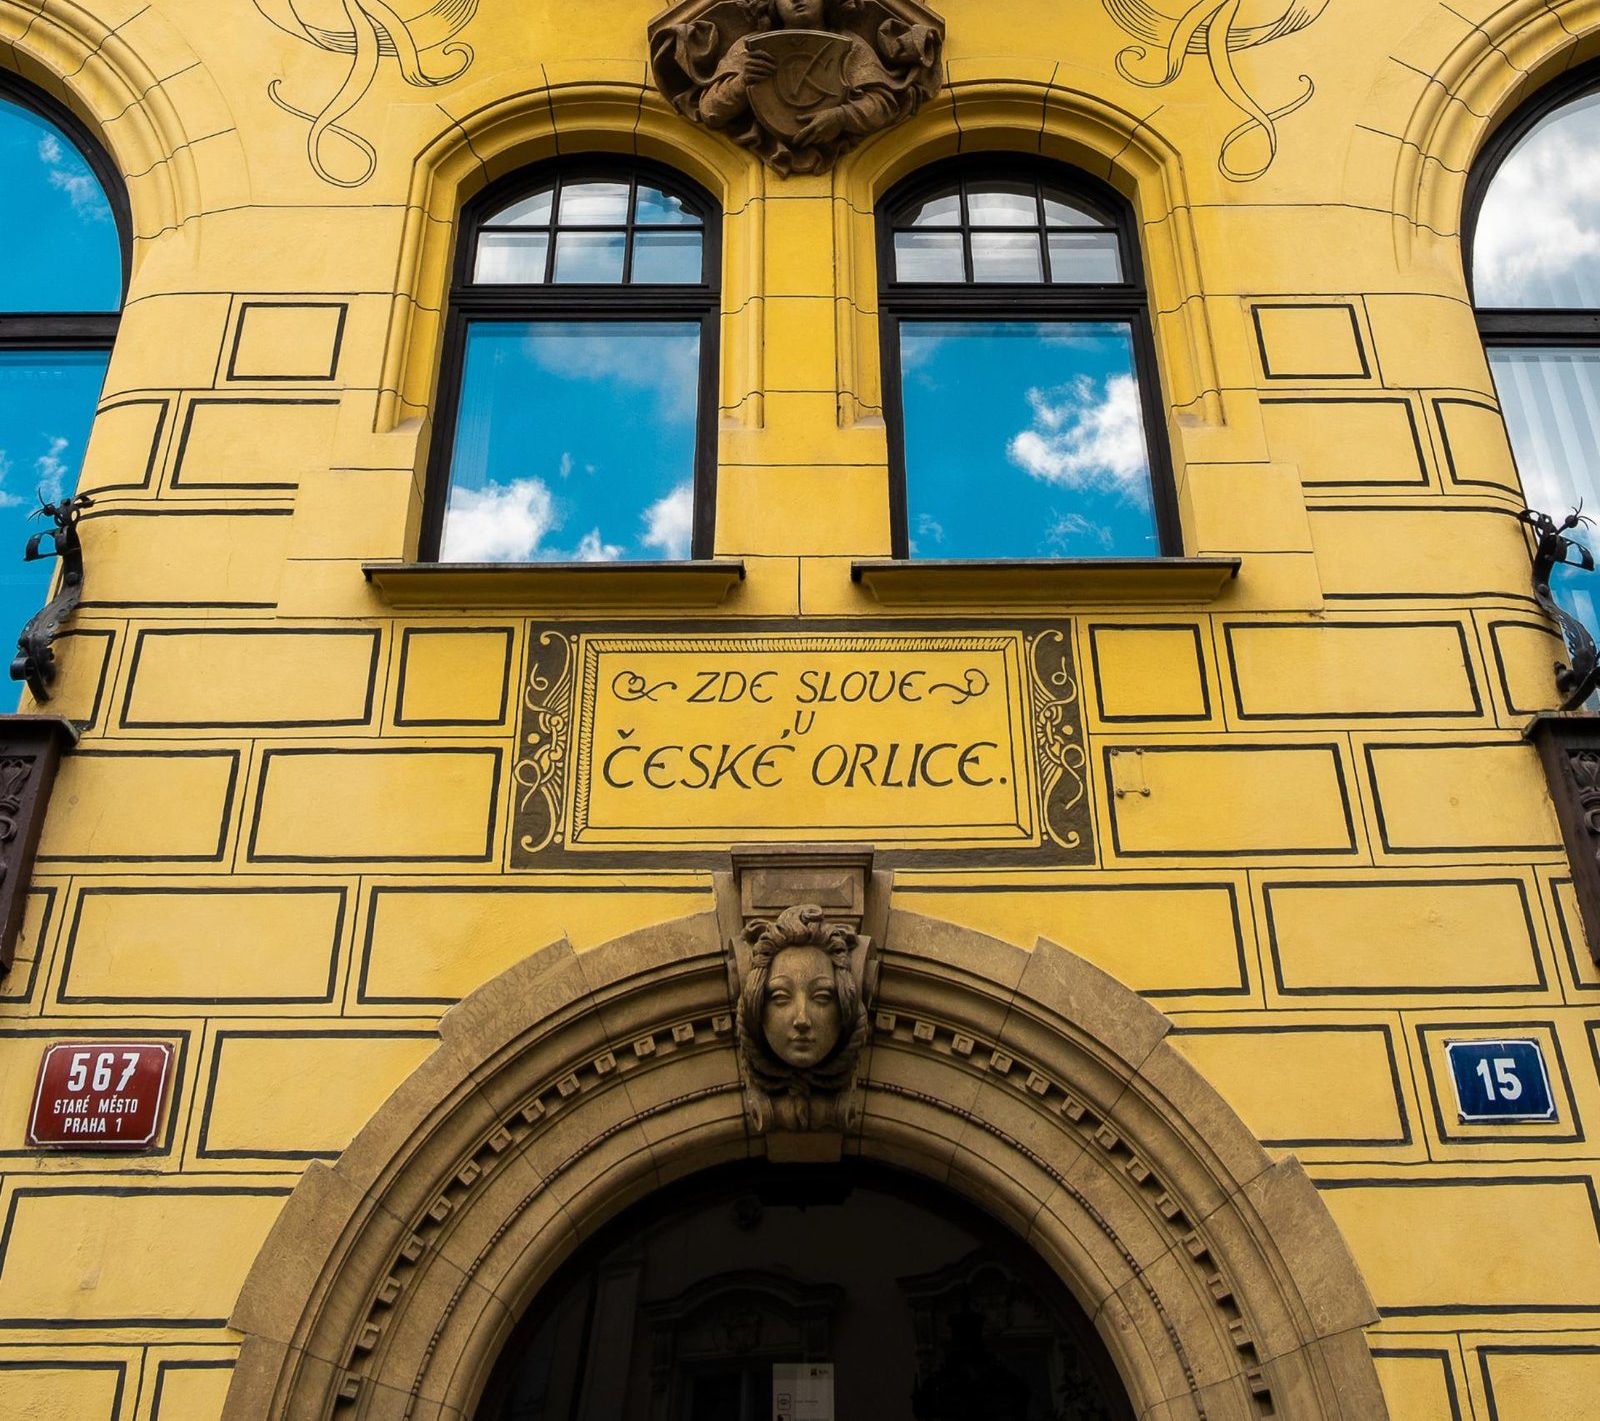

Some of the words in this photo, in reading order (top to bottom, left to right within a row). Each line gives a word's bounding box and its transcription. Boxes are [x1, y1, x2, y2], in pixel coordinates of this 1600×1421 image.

[686, 670, 779, 704] ZDE
[793, 709, 817, 736] U
[602, 727, 797, 790] ČESKÉ
[810, 740, 1008, 790] ORLICE.
[67, 1052, 141, 1092] 567
[1475, 1057, 1523, 1101] 15
[53, 1095, 90, 1114] STARÉ
[97, 1094, 139, 1114] MĚSTO
[63, 1117, 106, 1134] PRAHA
[115, 1117, 123, 1133] 1
